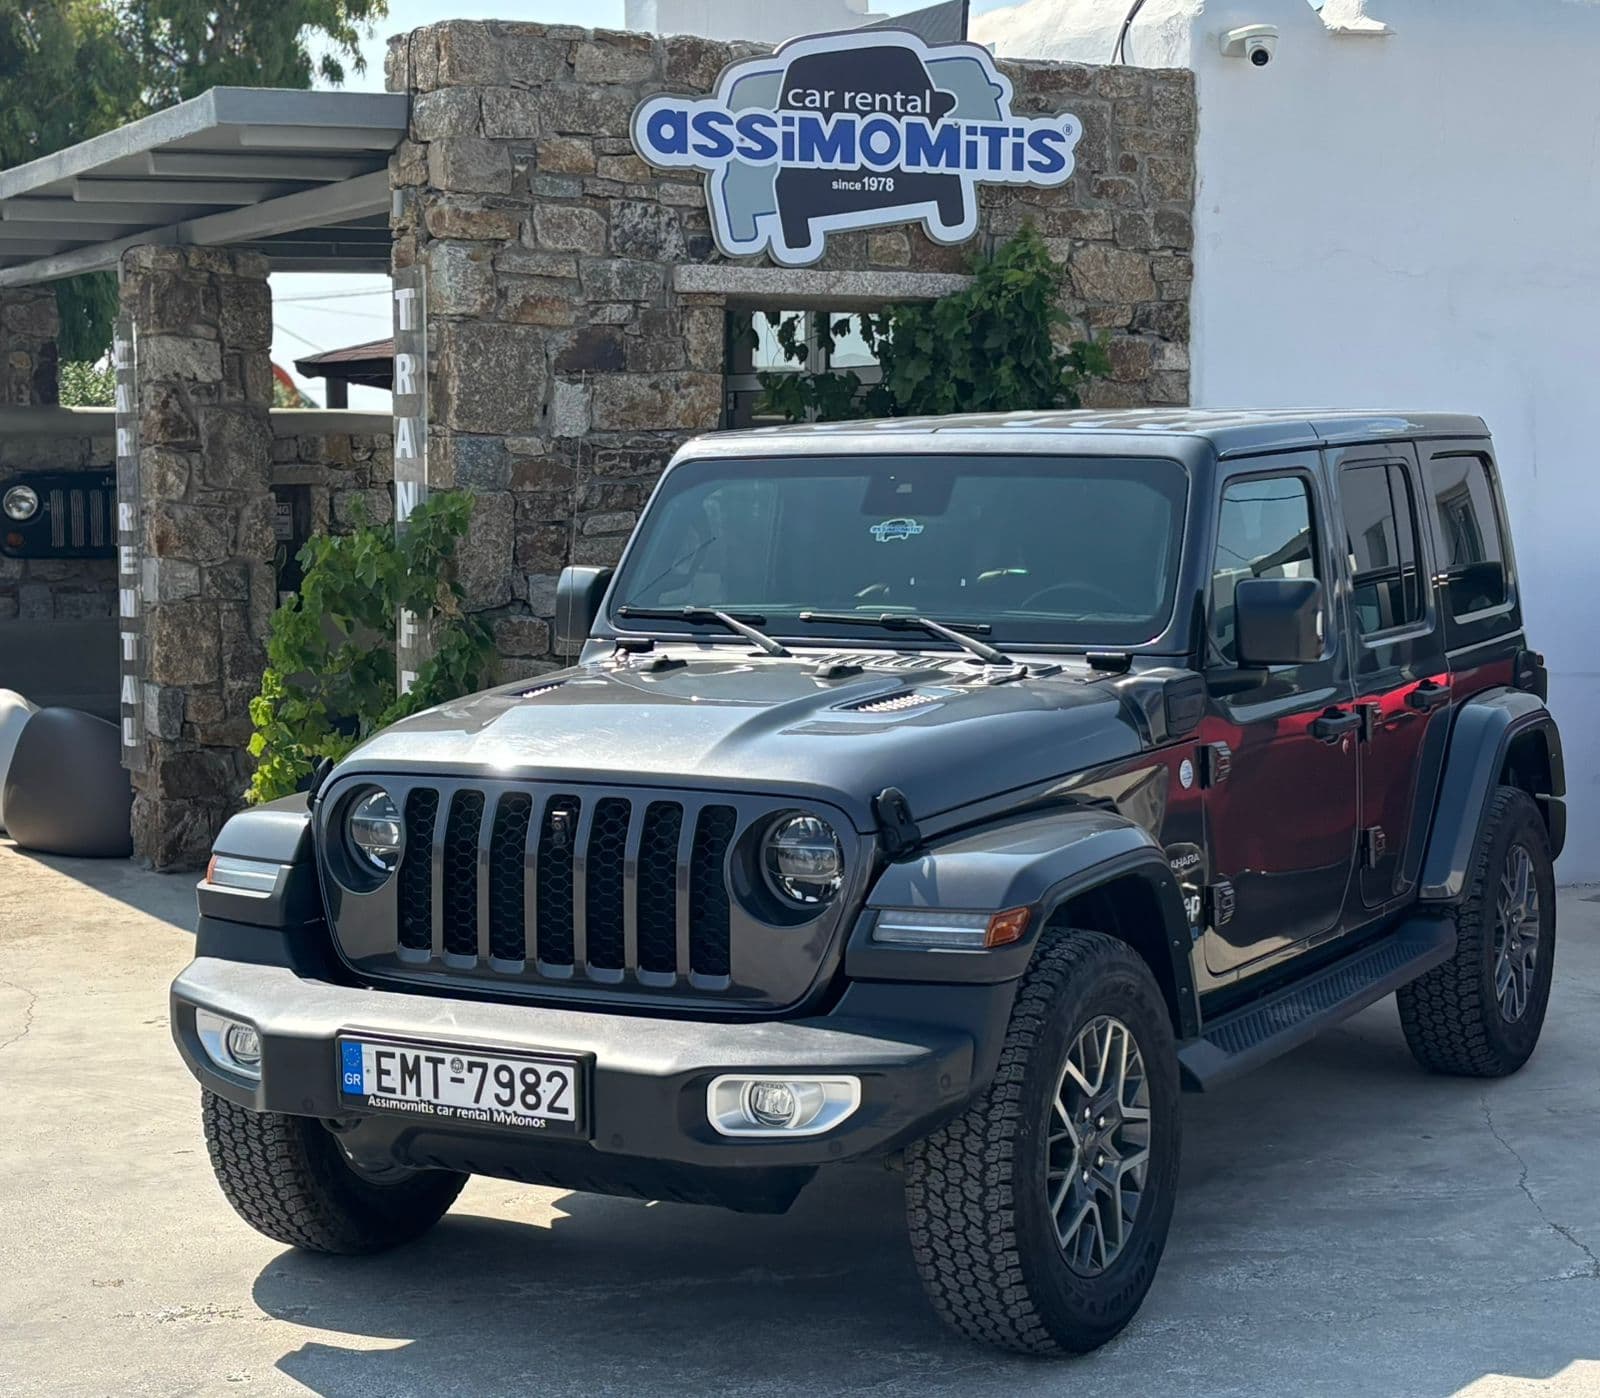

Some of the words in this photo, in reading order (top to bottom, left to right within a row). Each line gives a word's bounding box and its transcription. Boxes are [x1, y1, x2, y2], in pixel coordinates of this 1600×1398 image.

[787, 88, 835, 110] car
[843, 88, 931, 113] rental
[831, 178, 861, 191] since
[862, 177, 895, 192] 1978
[118, 502, 139, 747] RENTAL
[344, 1072, 361, 1086] GR
[375, 1050, 569, 1115] EMT-7982
[367, 1094, 434, 1114] Assimomitis
[436, 1104, 454, 1116] car
[456, 1106, 490, 1121] rental
[493, 1110, 546, 1128] Mykonos
